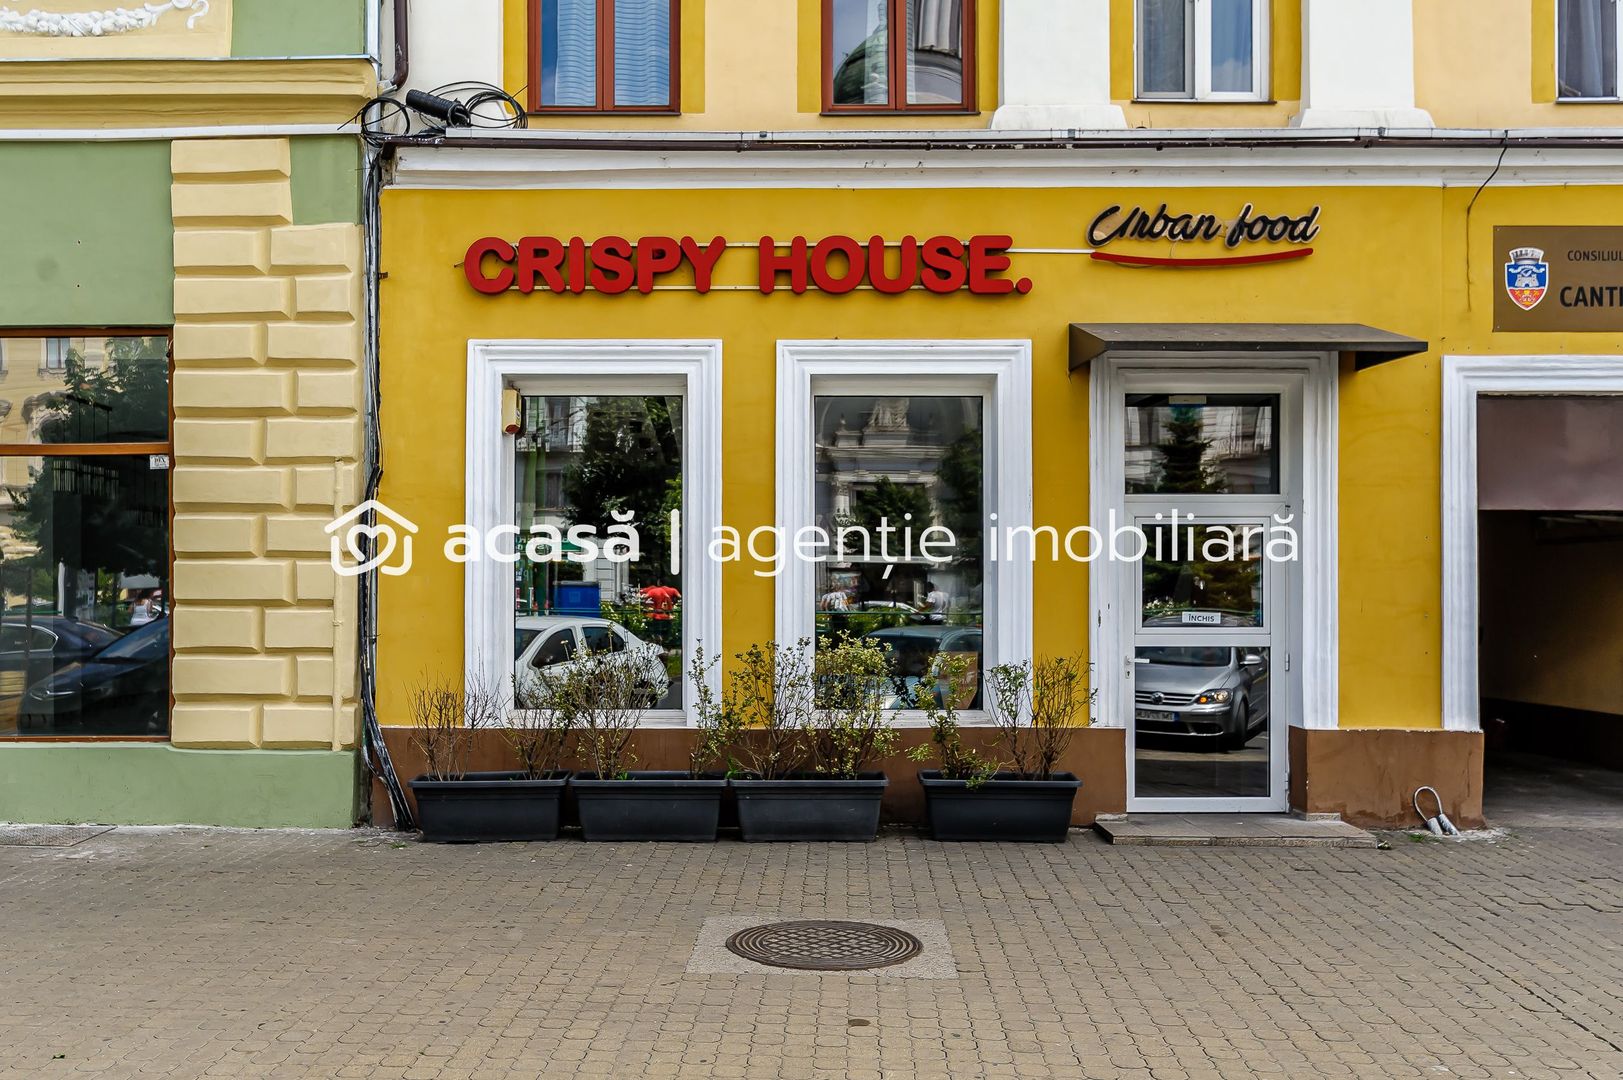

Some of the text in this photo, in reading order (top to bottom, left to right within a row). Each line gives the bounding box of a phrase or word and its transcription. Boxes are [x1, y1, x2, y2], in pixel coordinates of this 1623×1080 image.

[1087, 203, 1321, 248] Urban food
[464, 234, 1033, 294] CRISPY HOUSE.
[1567, 250, 1623, 261] CONSILIUL
[1188, 613, 1215, 623] ÎNCHIS
